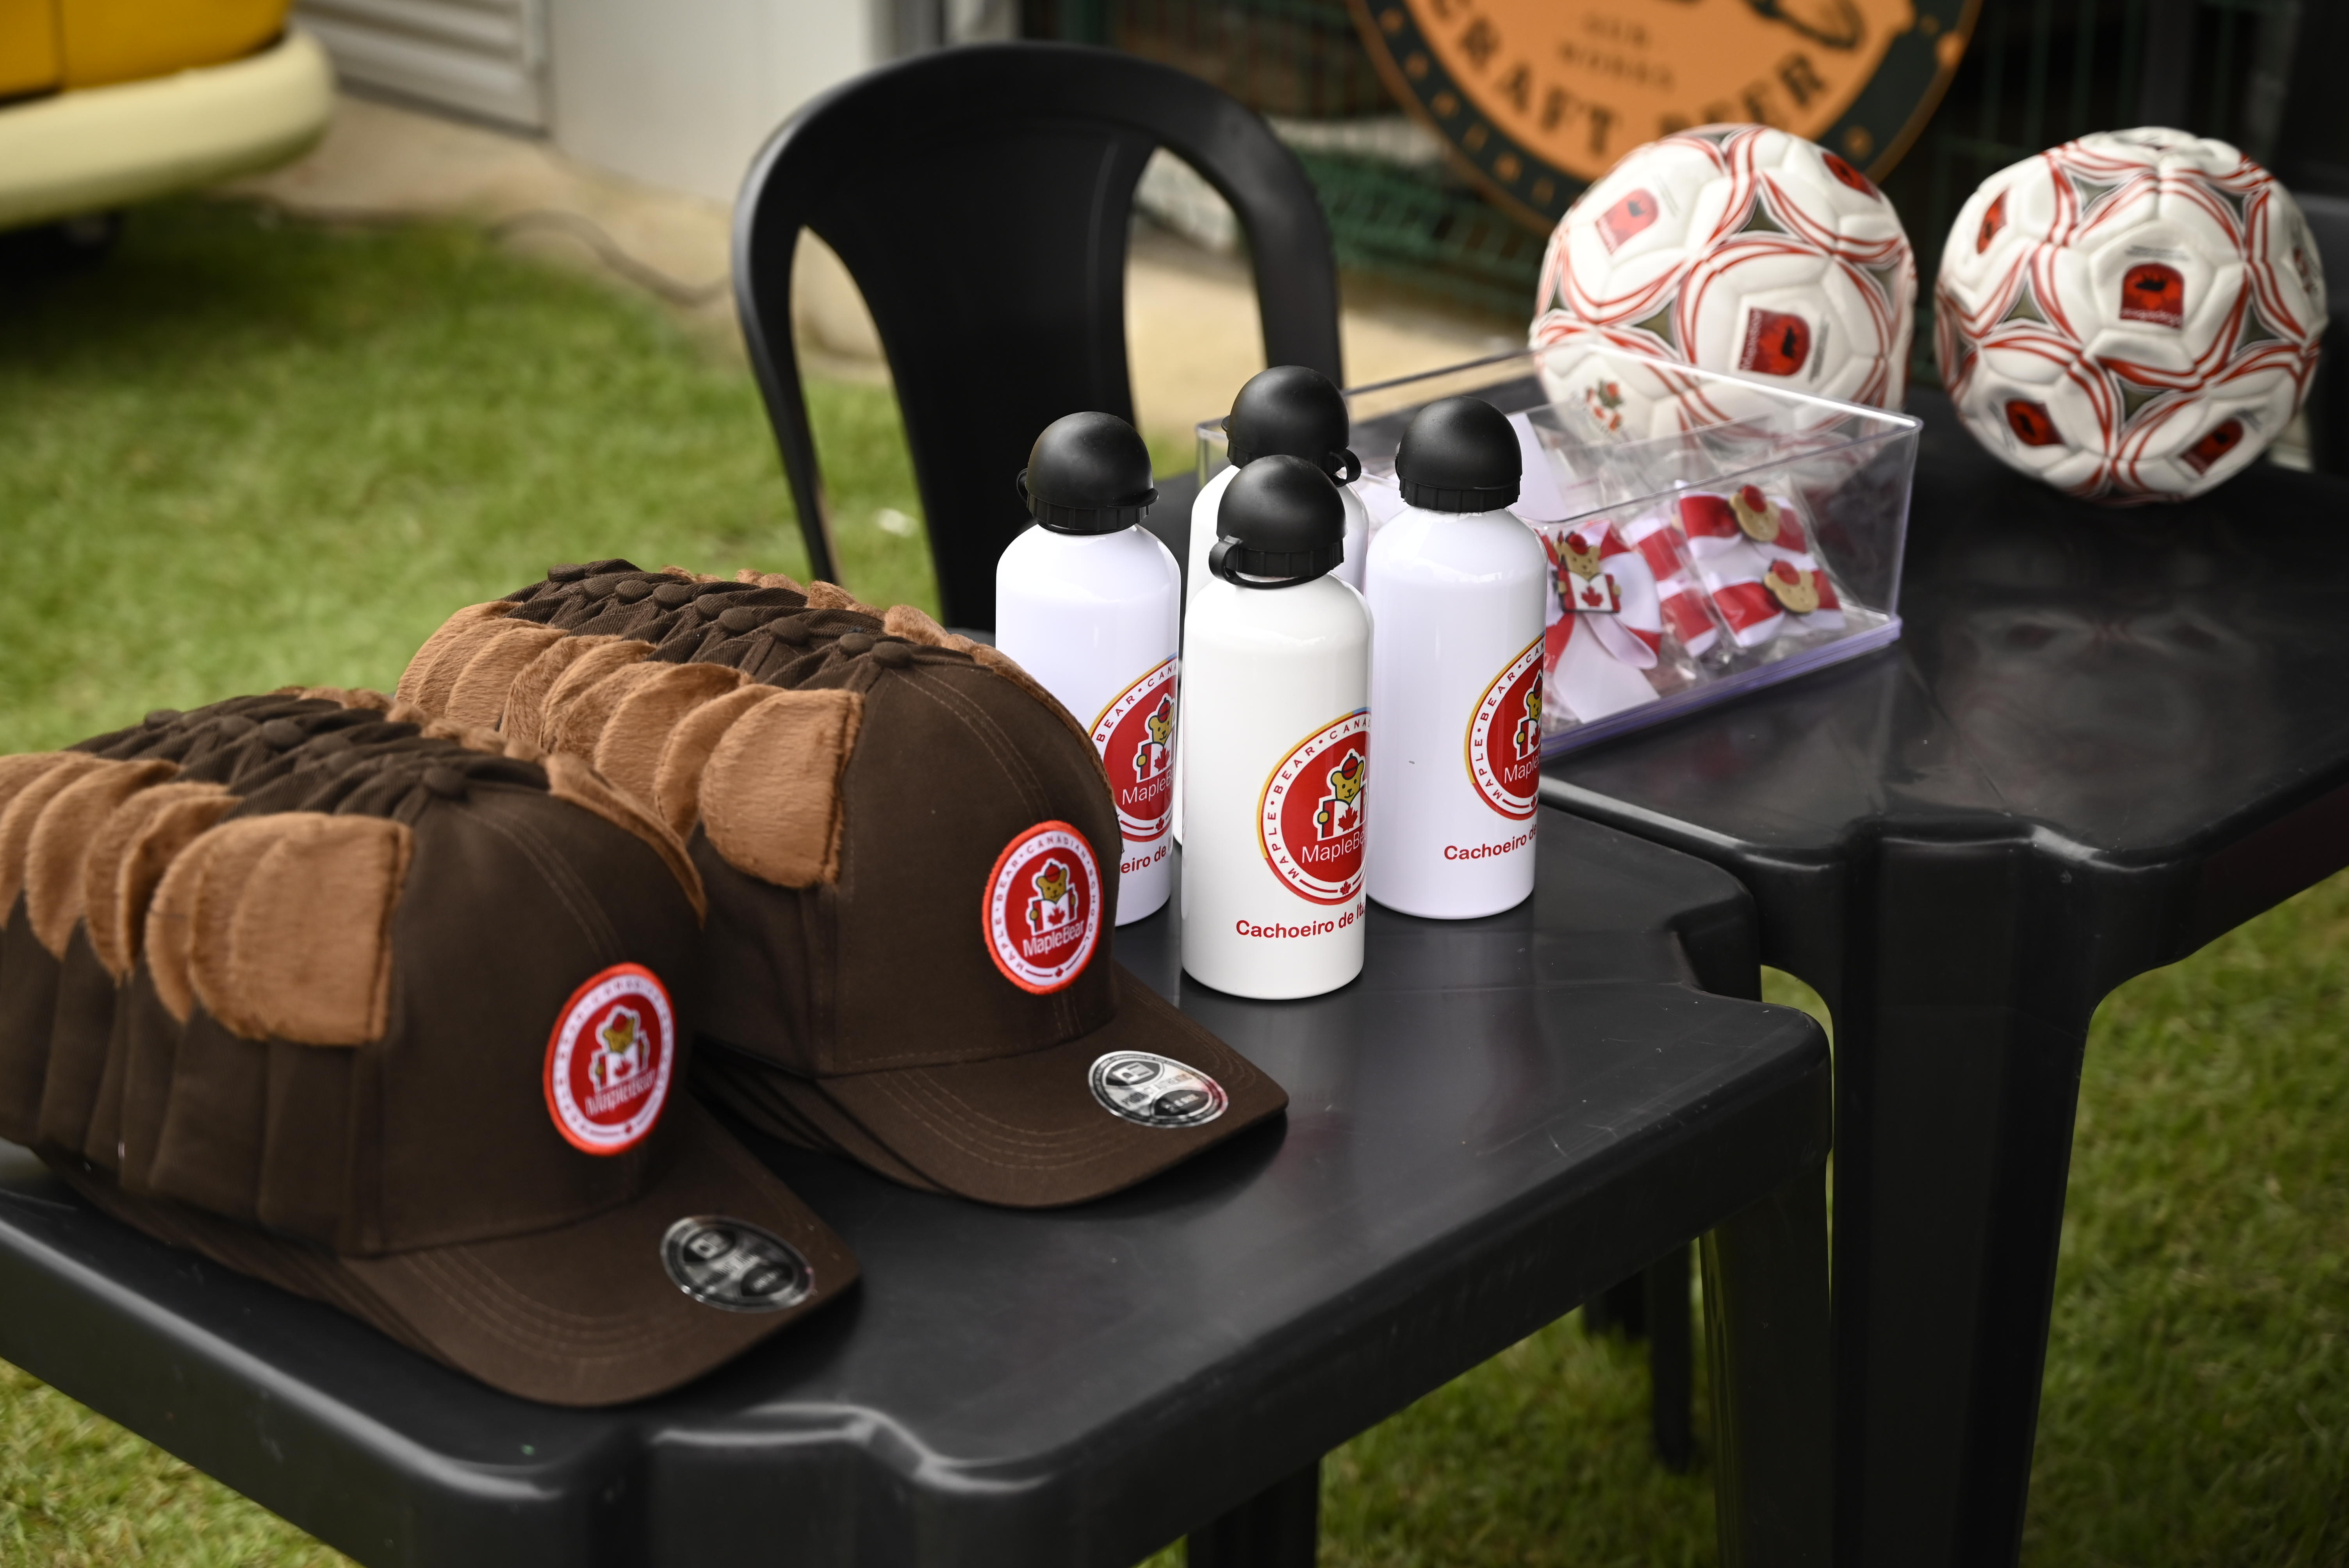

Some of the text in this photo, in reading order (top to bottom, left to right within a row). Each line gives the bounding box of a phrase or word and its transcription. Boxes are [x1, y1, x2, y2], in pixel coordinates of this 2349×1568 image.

[1096, 662, 1176, 743] BEAR CANA
[1474, 640, 1544, 800] MAPLE BEAR CAN
[1267, 717, 1371, 879] MAPLE BEAR CANAD
[1027, 836, 1087, 859] CANADIAN
[1120, 845, 1166, 874] eiro de
[1444, 823, 1536, 860] Cachoeiro de
[1022, 920, 1085, 957] MapleBear
[1236, 919, 1334, 939] Cachoeiro
[1338, 911, 1354, 929] de
